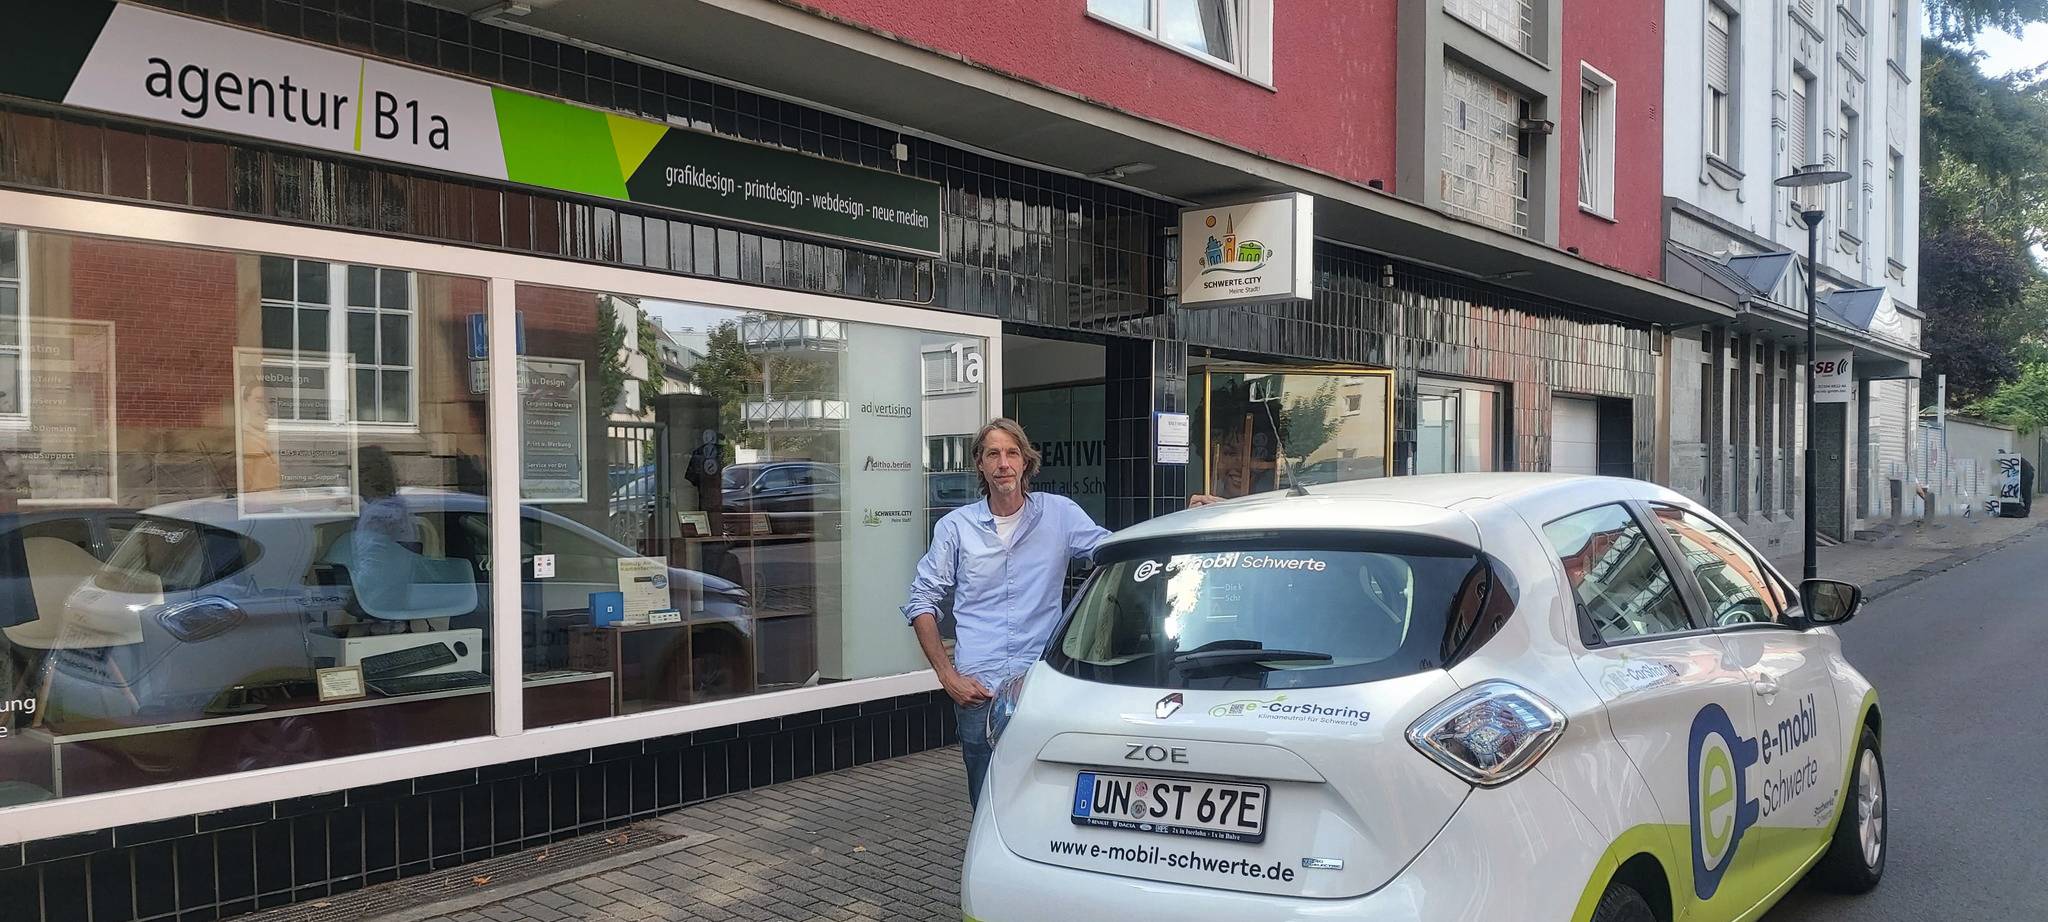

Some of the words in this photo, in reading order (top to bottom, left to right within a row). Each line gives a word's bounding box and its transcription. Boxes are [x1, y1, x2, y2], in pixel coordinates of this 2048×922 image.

[145, 57, 348, 130] agentur
[374, 91, 449, 150] B1a
[666, 165, 734, 196] grafikdesign
[745, 180, 802, 208] printdesign
[812, 192, 863, 220] webdesign
[872, 205, 895, 222] neue
[896, 209, 929, 228] medien
[1203, 276, 1262, 289] SCHWERTE.CITY
[951, 343, 984, 383] 1a
[1816, 361, 1834, 374] SB
[255, 373, 310, 384] webDesgn
[540, 378, 565, 387] Design
[1241, 555, 1327, 571] Schwerte
[1258, 714, 1306, 722] Klimaneutral
[1320, 717, 1358, 726] Schwerte
[1761, 693, 1817, 765] e-mobil
[1123, 743, 1190, 764] ZOE
[1762, 756, 1818, 817] Schwerte
[1080, 800, 1087, 809] D
[1093, 779, 1132, 815] UN
[1149, 783, 1192, 820] ST
[1197, 787, 1260, 828] 67E
